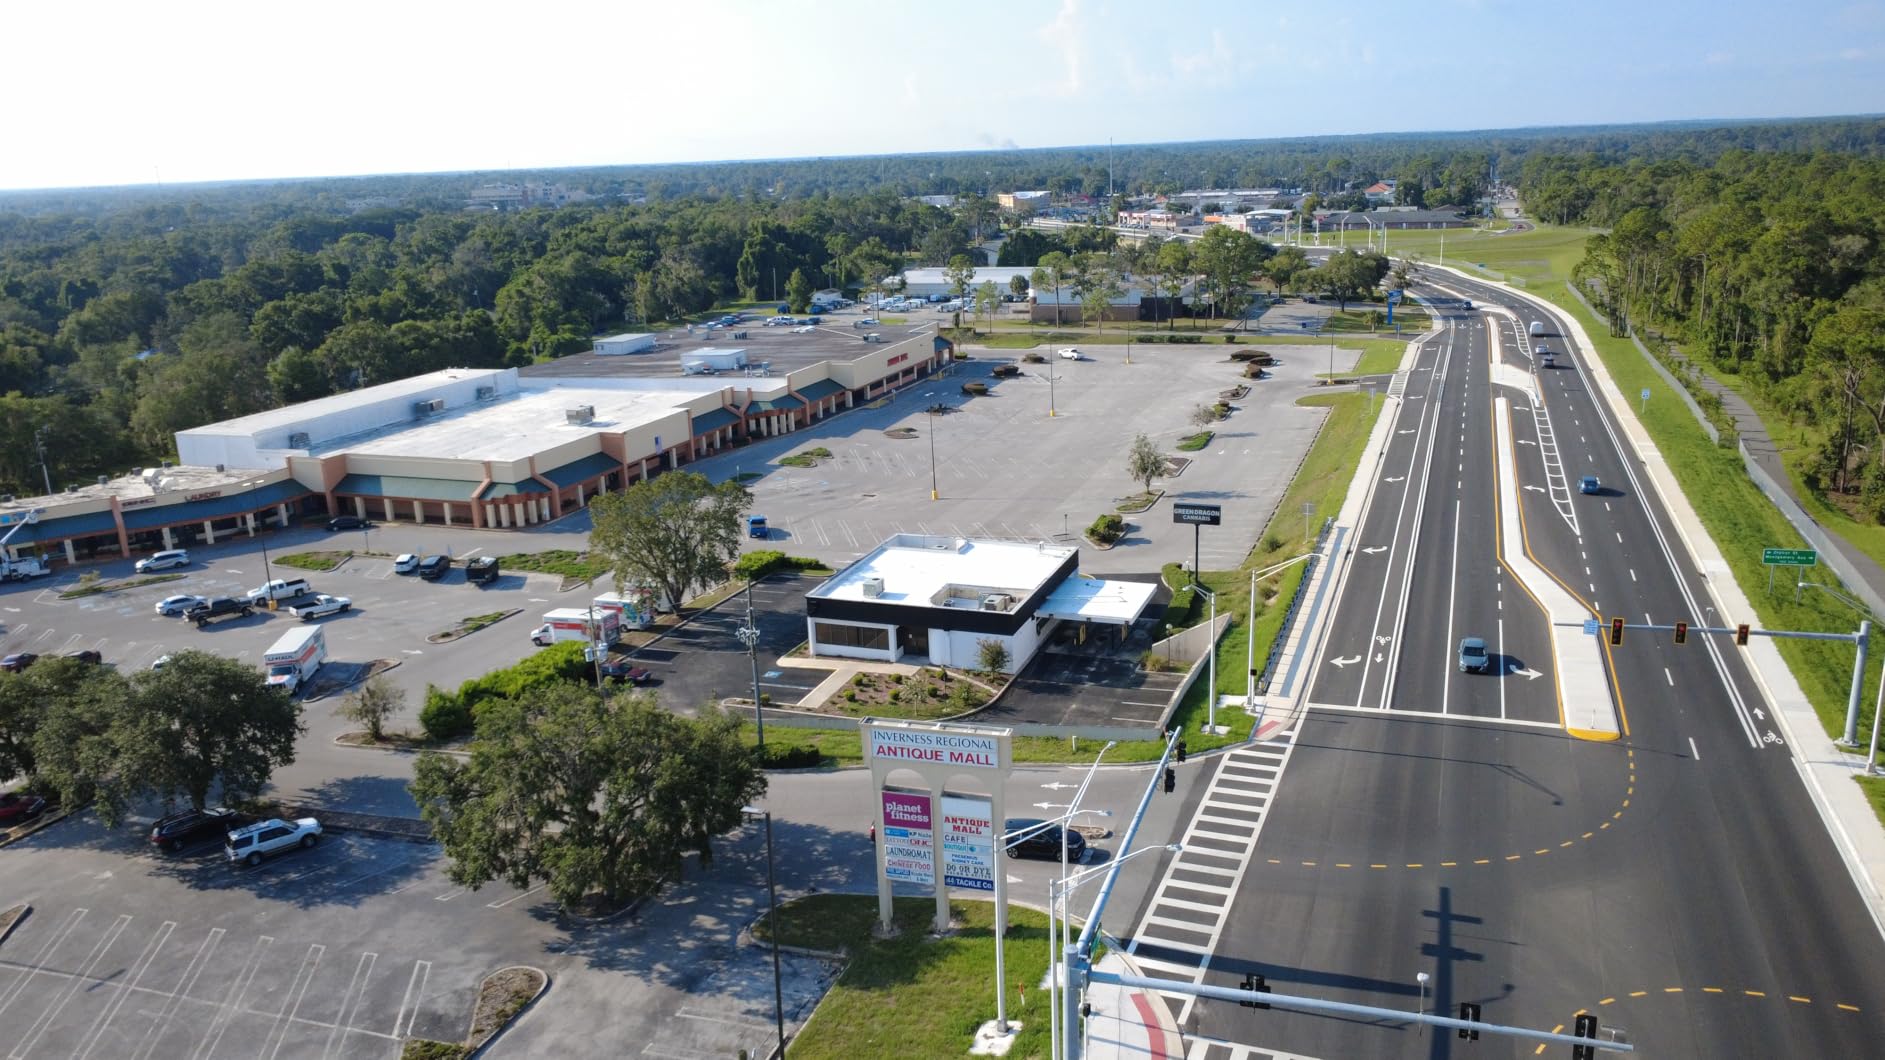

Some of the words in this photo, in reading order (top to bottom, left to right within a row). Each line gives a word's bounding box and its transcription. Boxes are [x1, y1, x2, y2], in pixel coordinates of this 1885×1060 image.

[873, 730, 932, 745] INVERNESS
[935, 735, 993, 750] REGIONAL
[876, 745, 944, 762] ANTIQUE
[949, 751, 994, 766] MALL
[885, 801, 922, 814] planet
[890, 811, 929, 823] fitness
[944, 816, 990, 828] ANTIQUE
[952, 824, 982, 835] MALL
[944, 834, 966, 843] CAFE
[886, 847, 931, 860] LAUNDROMAT
[888, 859, 913, 869] CHINESE
[915, 862, 931, 870] FOOD
[959, 865, 971, 873] OR
[973, 866, 991, 876] DYE
[956, 878, 982, 888] TACKLE
